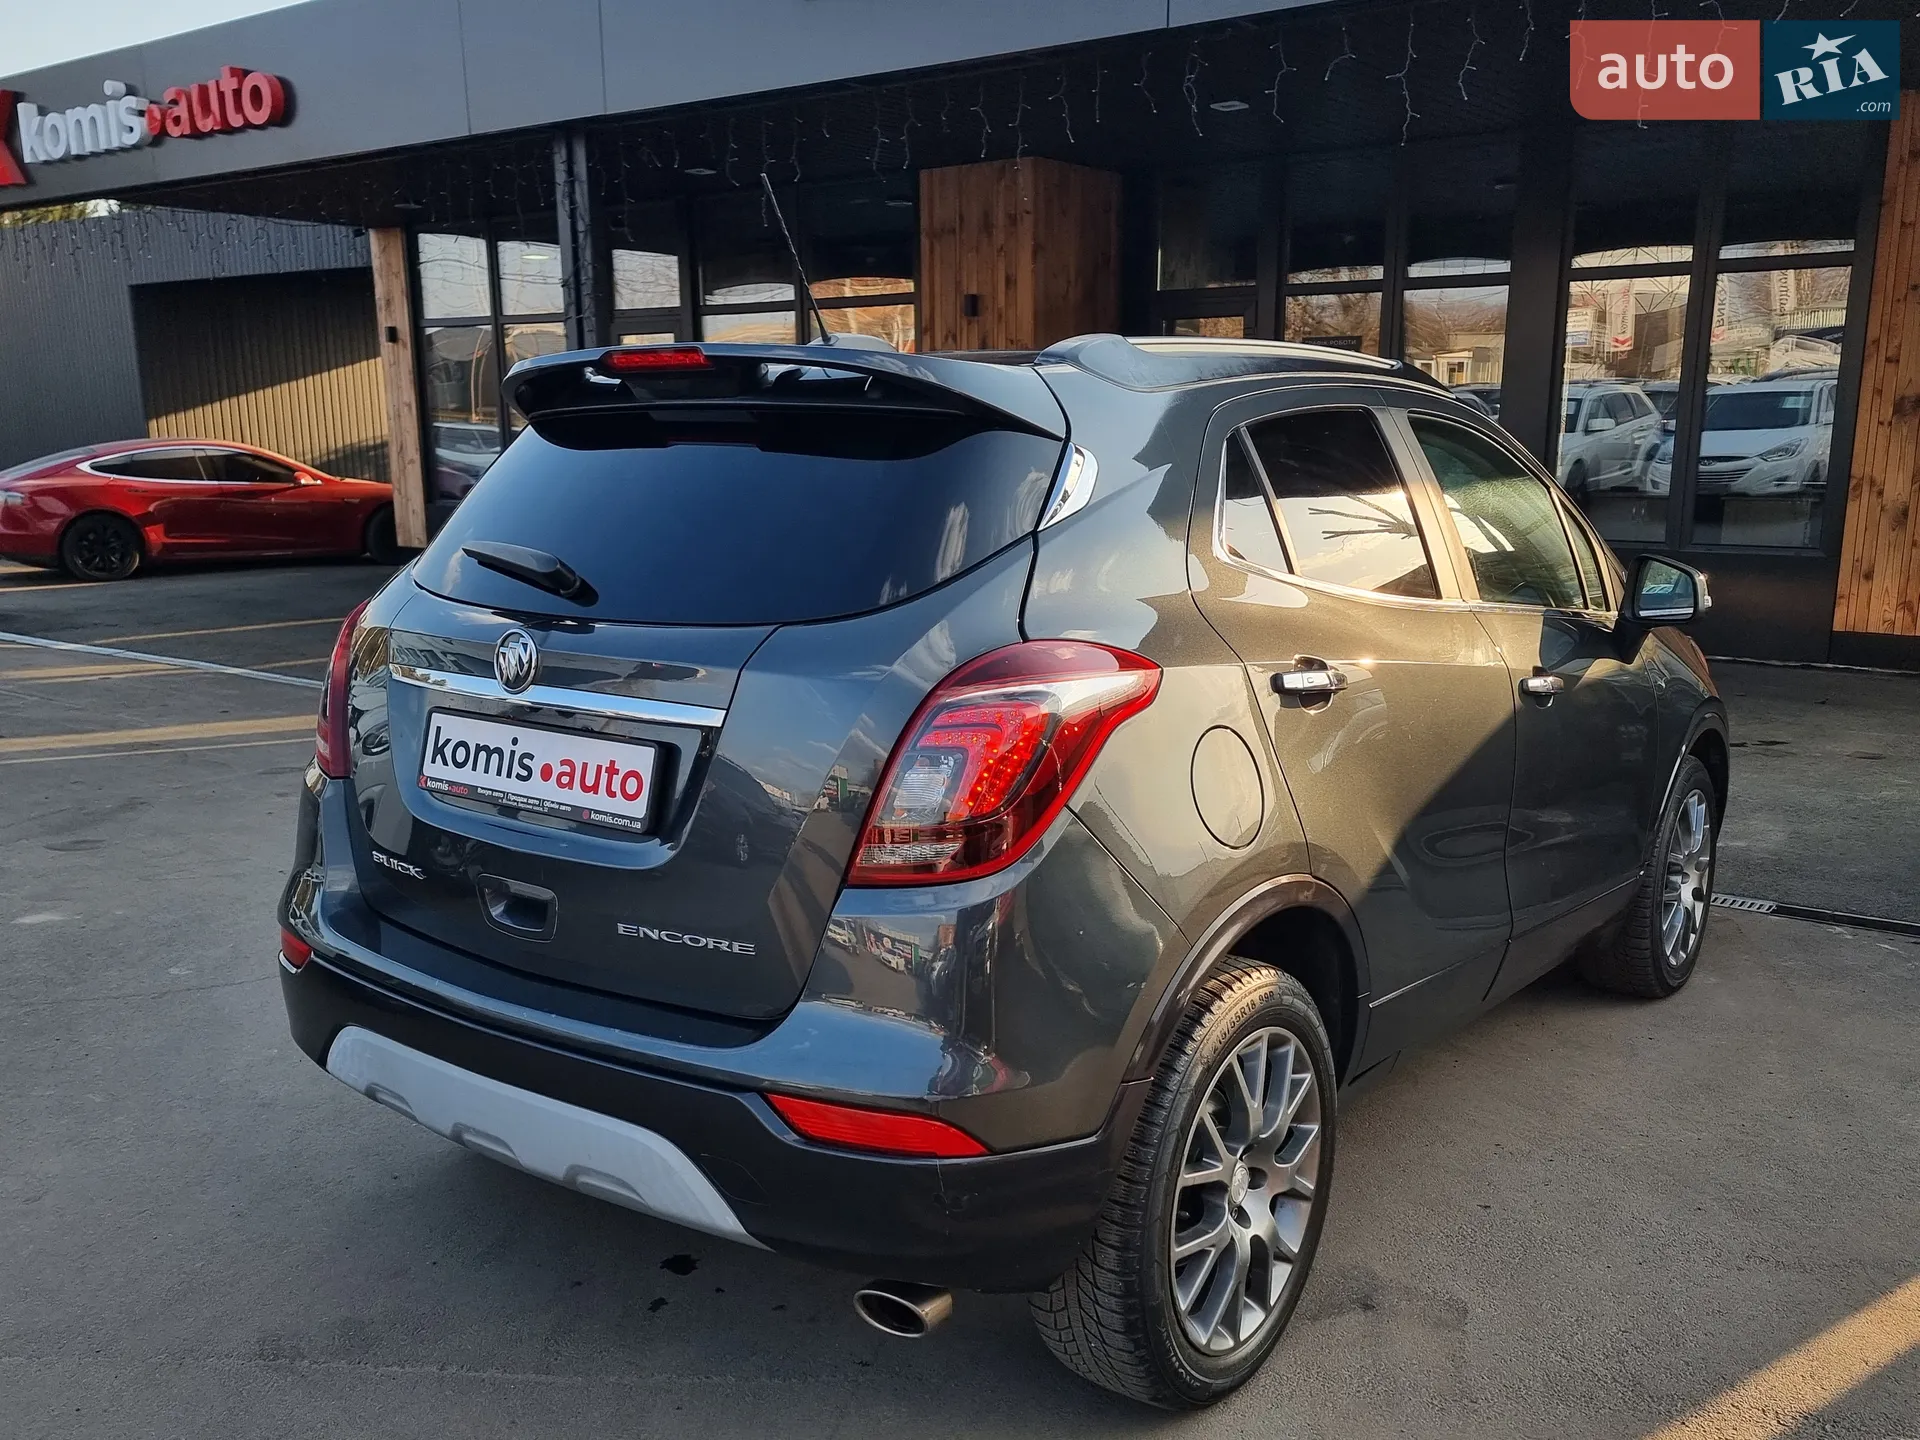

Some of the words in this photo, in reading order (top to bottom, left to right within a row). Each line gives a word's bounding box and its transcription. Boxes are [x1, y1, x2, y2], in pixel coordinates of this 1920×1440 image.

[590, 810, 642, 829] komis.com.ua
[371, 850, 427, 880] BUICK
[616, 922, 757, 956] ENCORE
